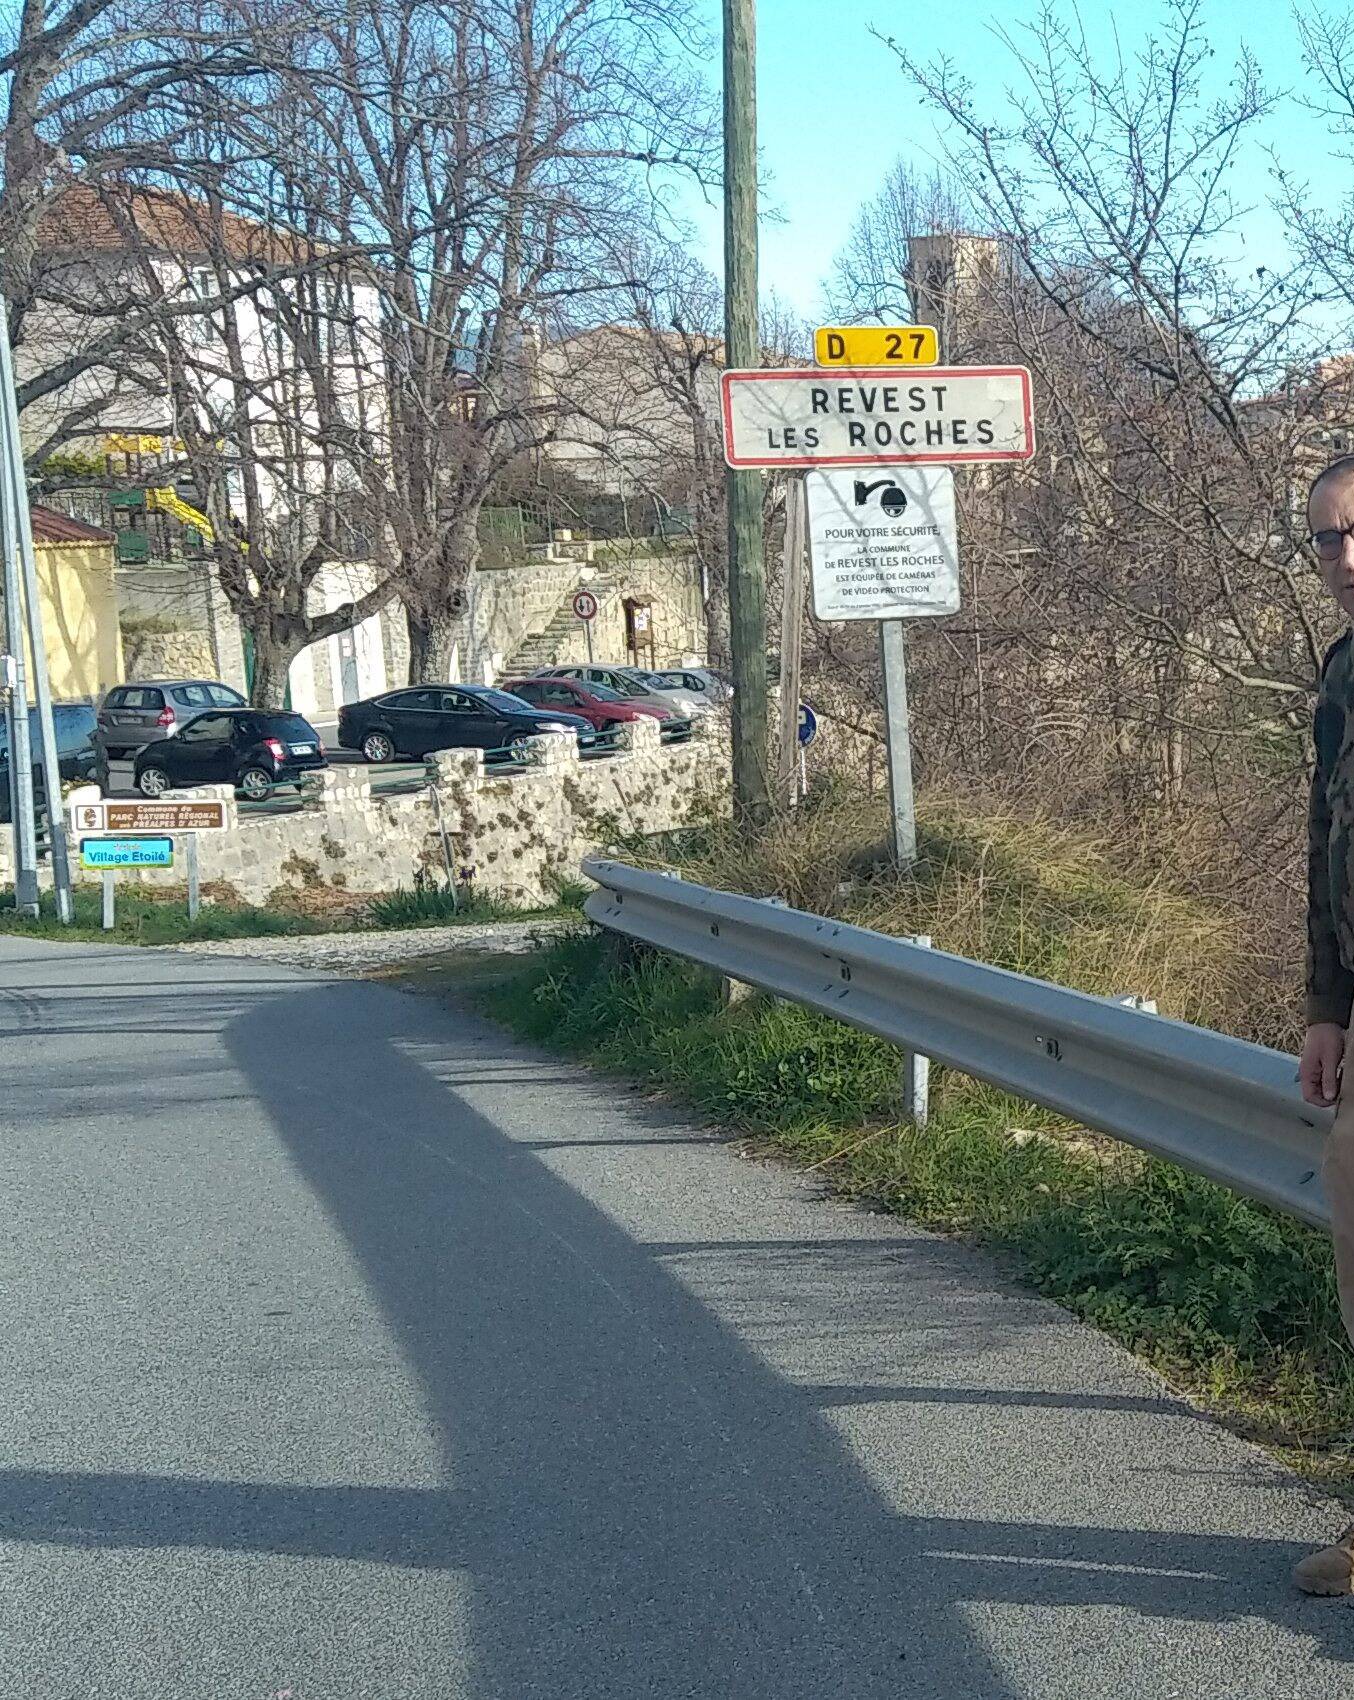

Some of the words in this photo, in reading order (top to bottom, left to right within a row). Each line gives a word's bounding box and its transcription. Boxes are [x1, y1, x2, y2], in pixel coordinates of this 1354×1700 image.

[828, 334, 845, 359] D
[885, 334, 925, 359] 27
[812, 386, 947, 414] REVEST
[768, 427, 819, 449] LES
[849, 419, 994, 447] ROCHES
[825, 528, 854, 539] POUR
[854, 527, 889, 538] VOTRE
[857, 546, 867, 554] LA
[869, 545, 911, 554] COMMUNE
[837, 557, 877, 568] REVEST
[880, 556, 899, 567] LES
[902, 555, 945, 566] ROCHES
[836, 574, 849, 582] EST
[886, 572, 897, 580] DE
[898, 571, 936, 580] CAMÉRAS
[842, 588, 853, 596] DE
[854, 586, 879, 596] VIDÉO
[880, 585, 930, 595] PROTECTION
[137, 805, 179, 813] Commune
[110, 813, 135, 821] PARC
[137, 812, 176, 821] NATUREL
[89, 852, 129, 864] Village
